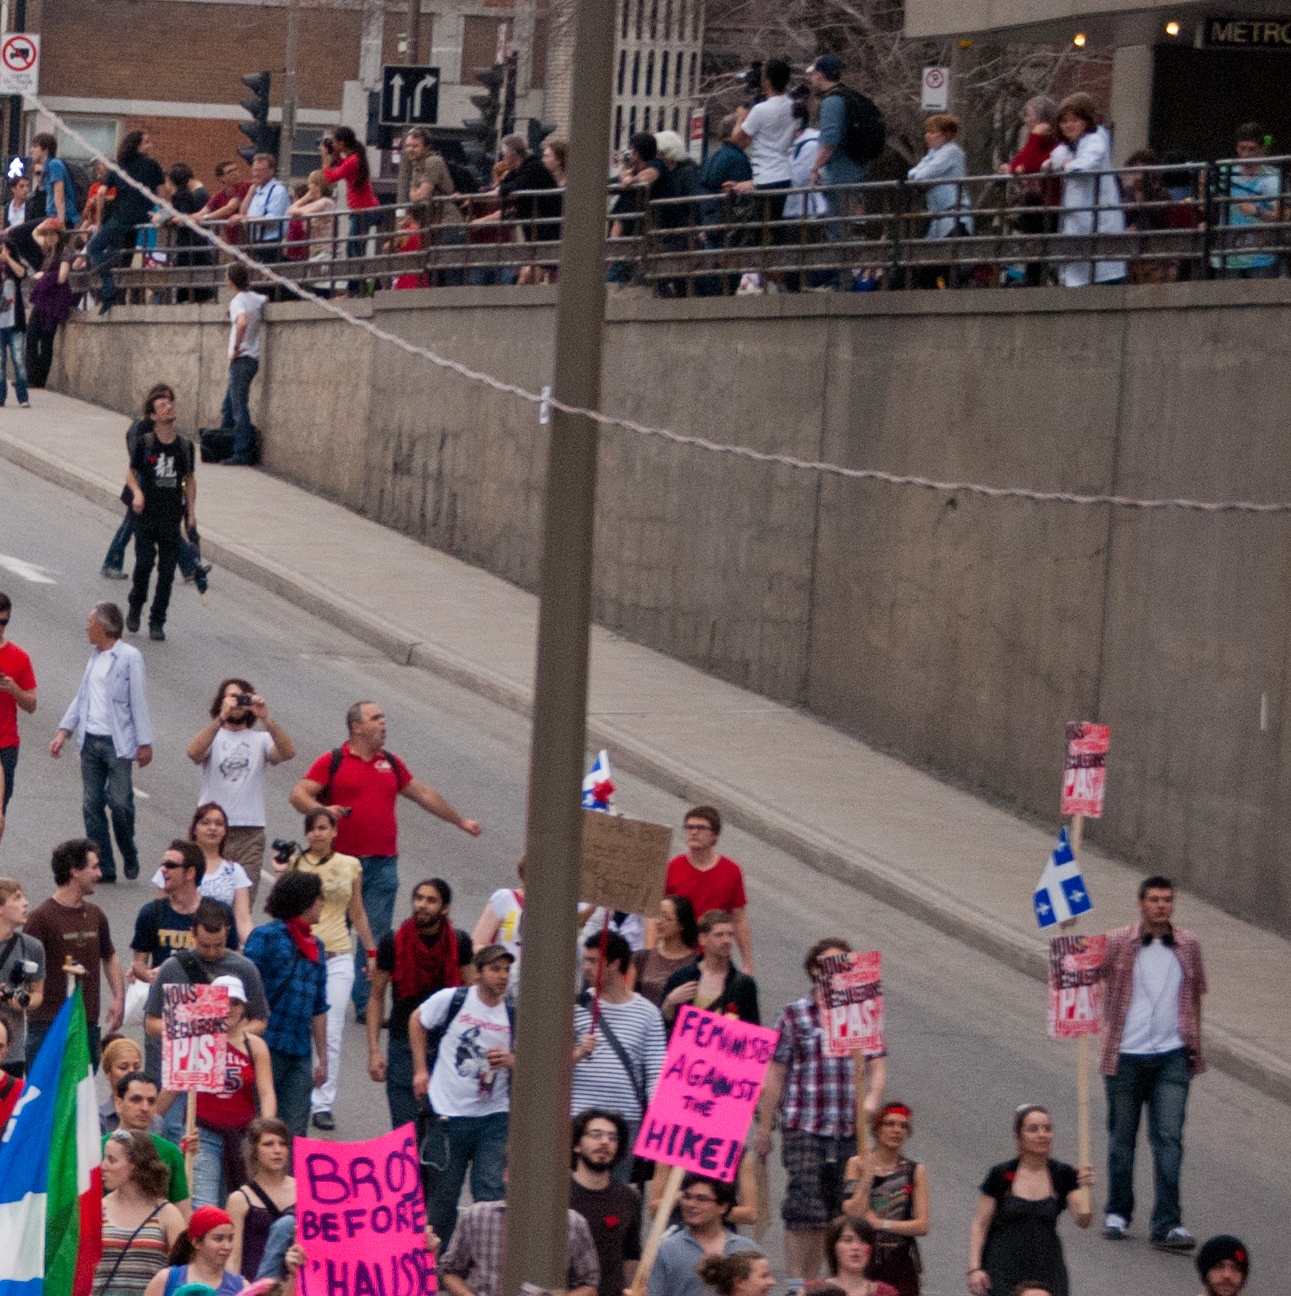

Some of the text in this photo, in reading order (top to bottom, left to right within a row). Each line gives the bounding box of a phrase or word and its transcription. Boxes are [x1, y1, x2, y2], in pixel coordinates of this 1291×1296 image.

[171, 1037, 220, 1072] PAS
[644, 1121, 738, 1178] HIKE!
[306, 1151, 419, 1204] BROS
[303, 1201, 425, 1241] BEFORE
